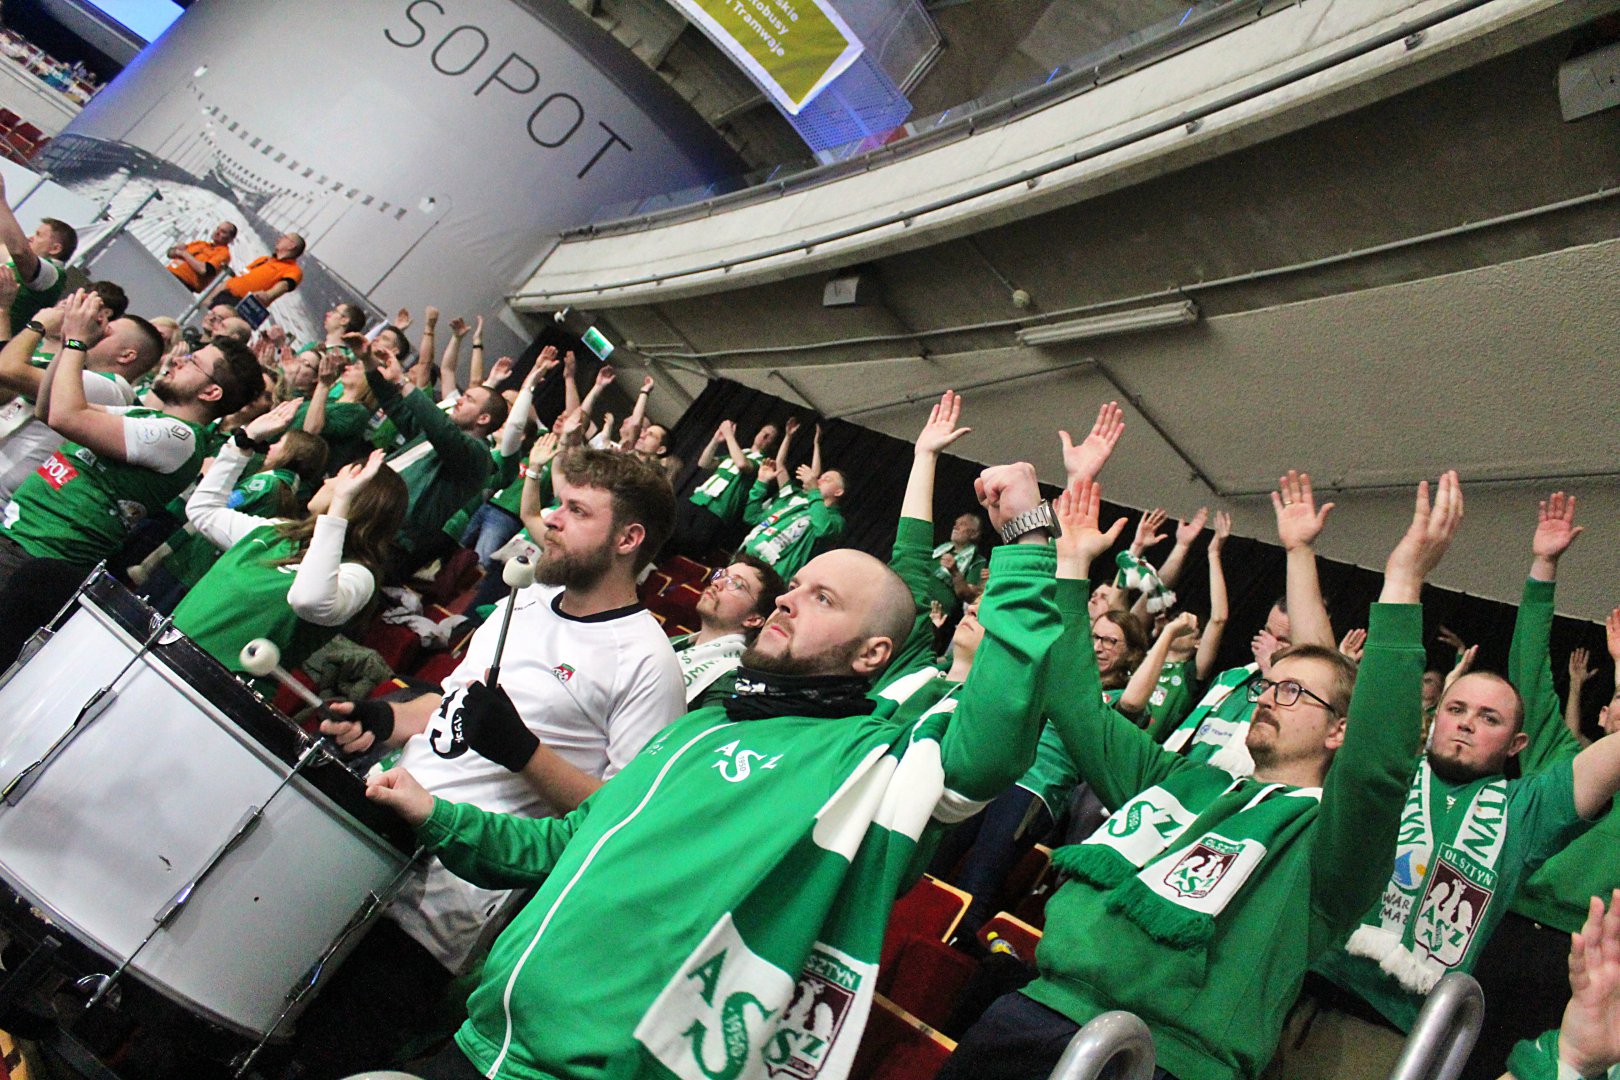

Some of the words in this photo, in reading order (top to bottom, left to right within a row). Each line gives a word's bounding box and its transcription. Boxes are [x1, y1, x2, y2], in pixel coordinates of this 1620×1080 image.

[749, 0, 789, 35] tobusy
[774, 0, 799, 22] skie
[733, 1, 785, 57] Tramwaje
[384, 0, 633, 179] SOPOT
[1445, 850, 1494, 886] OLSZTYN
[805, 954, 856, 989] SZTYN
